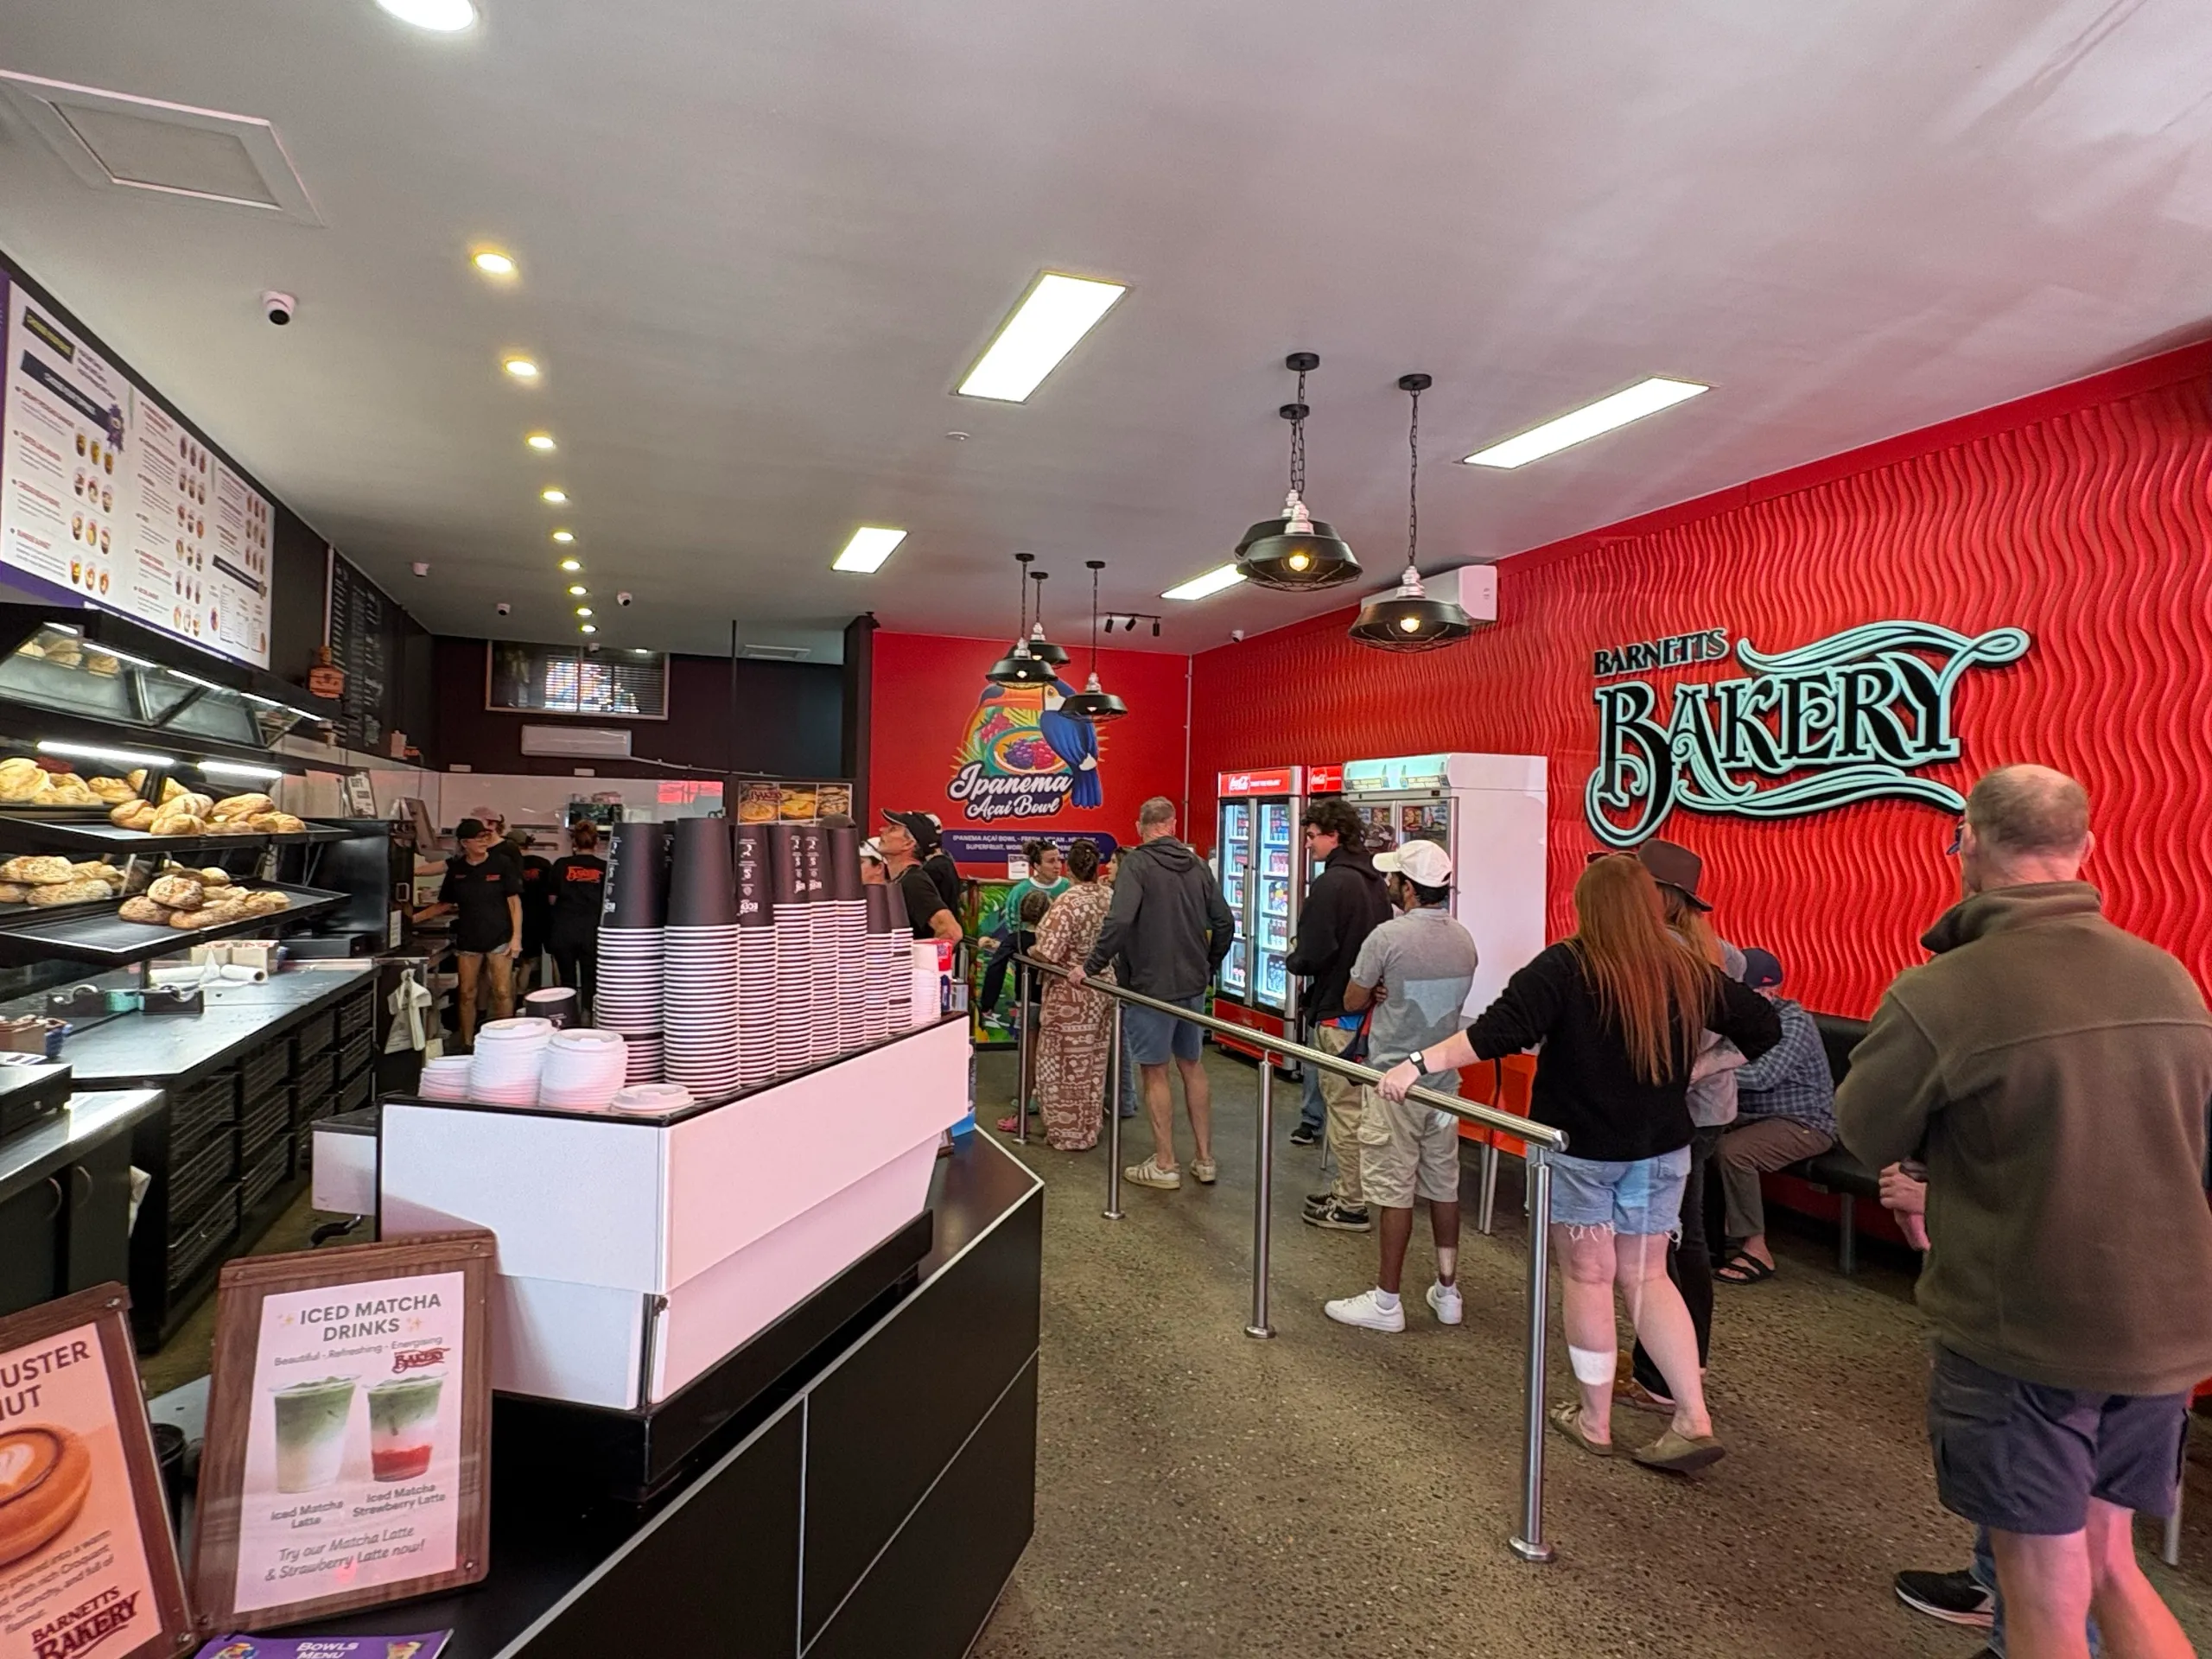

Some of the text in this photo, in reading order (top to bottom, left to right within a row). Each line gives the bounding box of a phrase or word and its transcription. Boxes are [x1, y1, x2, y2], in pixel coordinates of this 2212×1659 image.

[1586, 635, 1996, 847] BAKERY
[950, 763, 1074, 801] Ipanema
[1014, 794, 1061, 816] Bowl
[300, 1294, 442, 1325] ICED MATCHA
[323, 1318, 400, 1342] DRINKS
[274, 1351, 321, 1367] Beautiful
[327, 1344, 383, 1359] Refreshing
[353, 1493, 446, 1518] Strawberry Latte
[366, 1484, 436, 1503] Iced Matcha
[270, 1500, 344, 1521] Iced Matcha
[291, 1516, 321, 1529] Latte
[278, 1526, 415, 1563] Try our Matcha Latte
[264, 1538, 425, 1582] & Strawberry Latte now!
[31, 1586, 120, 1643] BARNETTS
[33, 1590, 141, 1659] BAKERY
[297, 1643, 359, 1651] BOWLS
